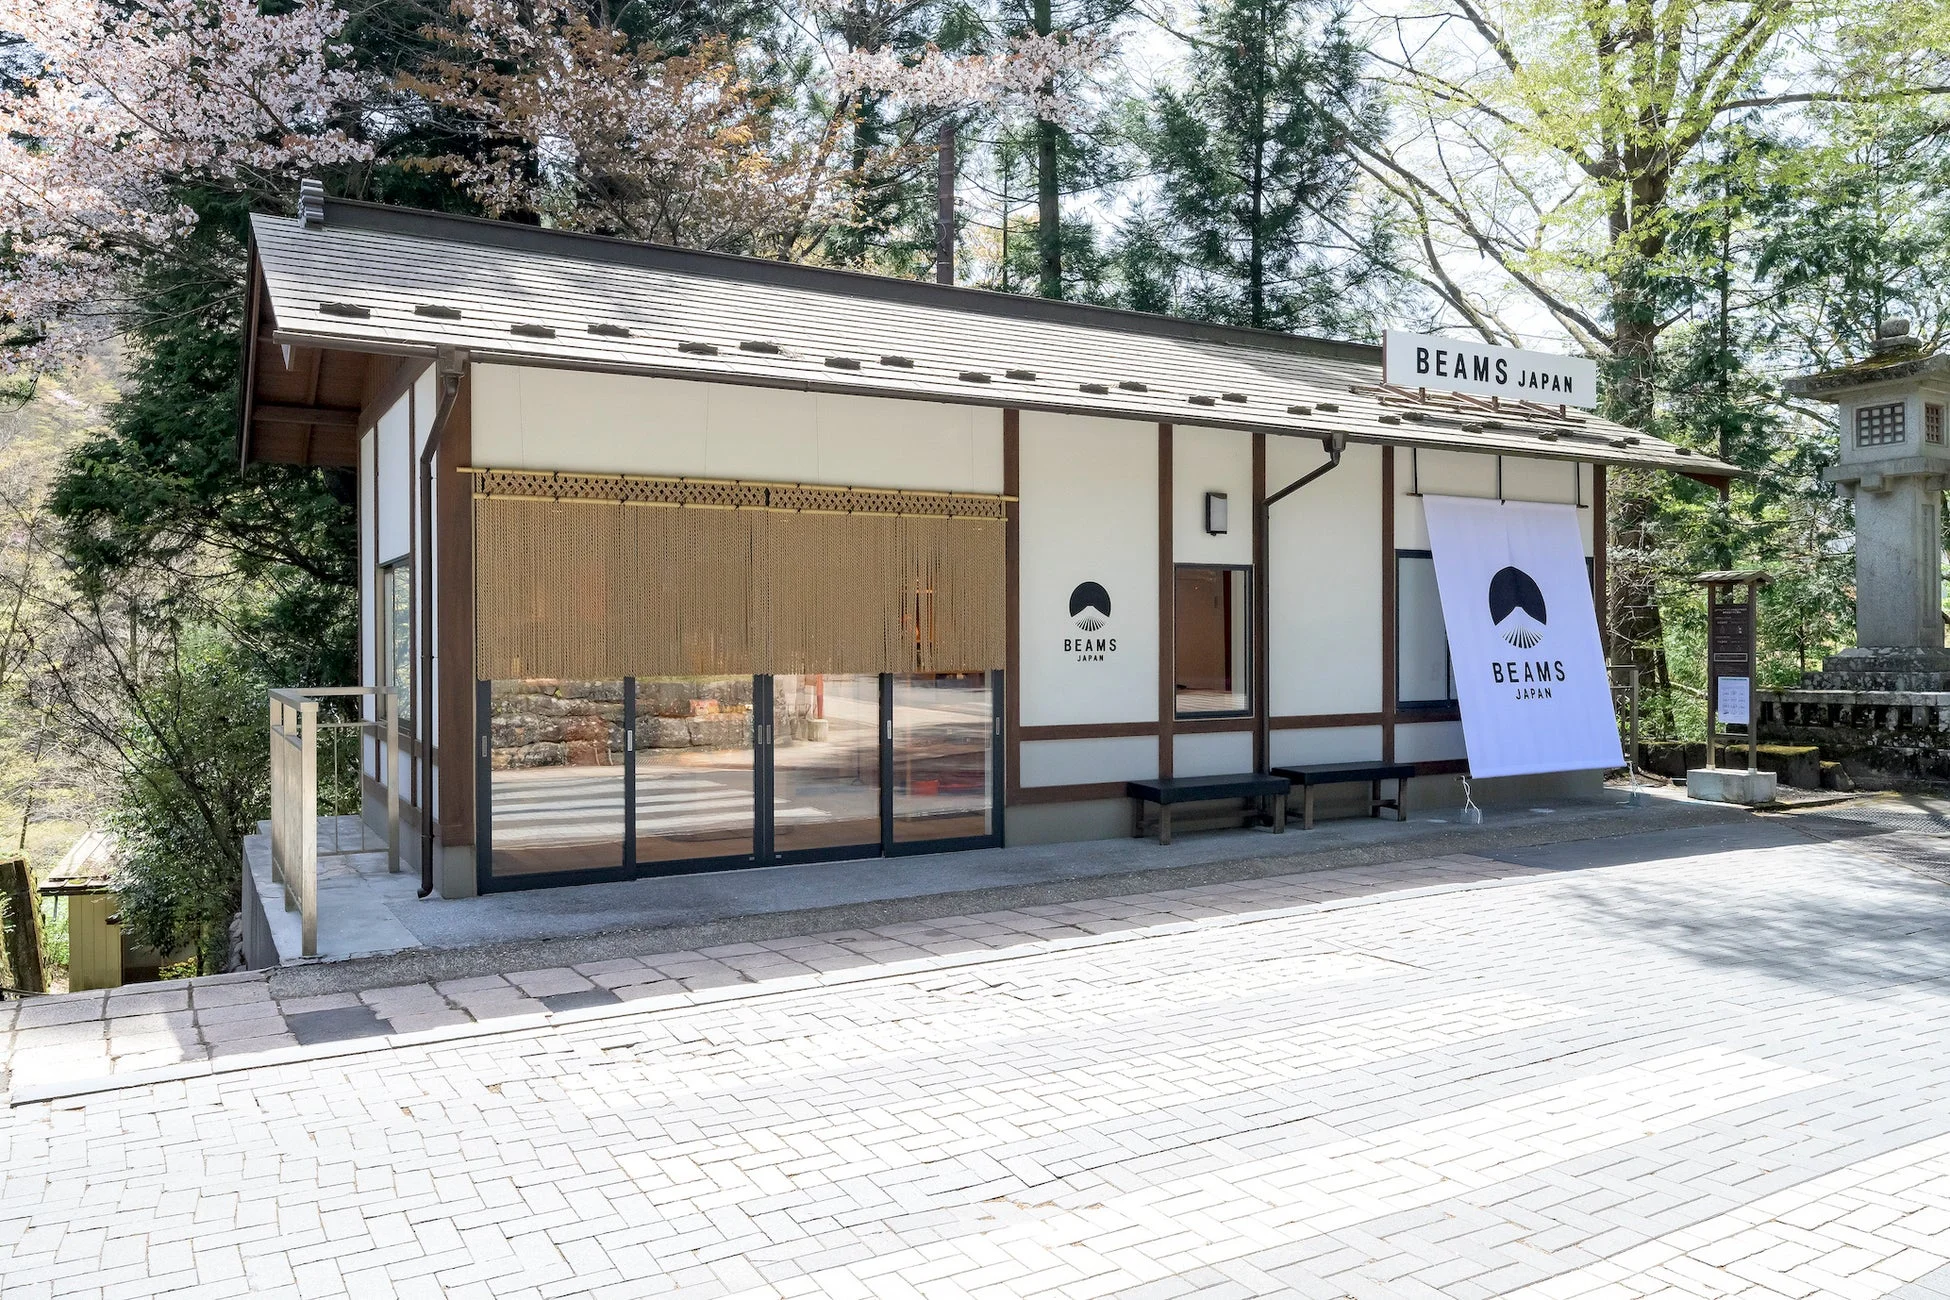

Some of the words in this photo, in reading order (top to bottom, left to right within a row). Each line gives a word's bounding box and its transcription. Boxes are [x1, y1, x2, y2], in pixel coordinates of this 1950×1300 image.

[1416, 346, 1508, 385] BEAMS
[1518, 369, 1573, 394] JAPAN
[1064, 638, 1117, 652] BEAMS
[1492, 660, 1566, 683] BEAMS
[1515, 687, 1552, 700] JAPAN
